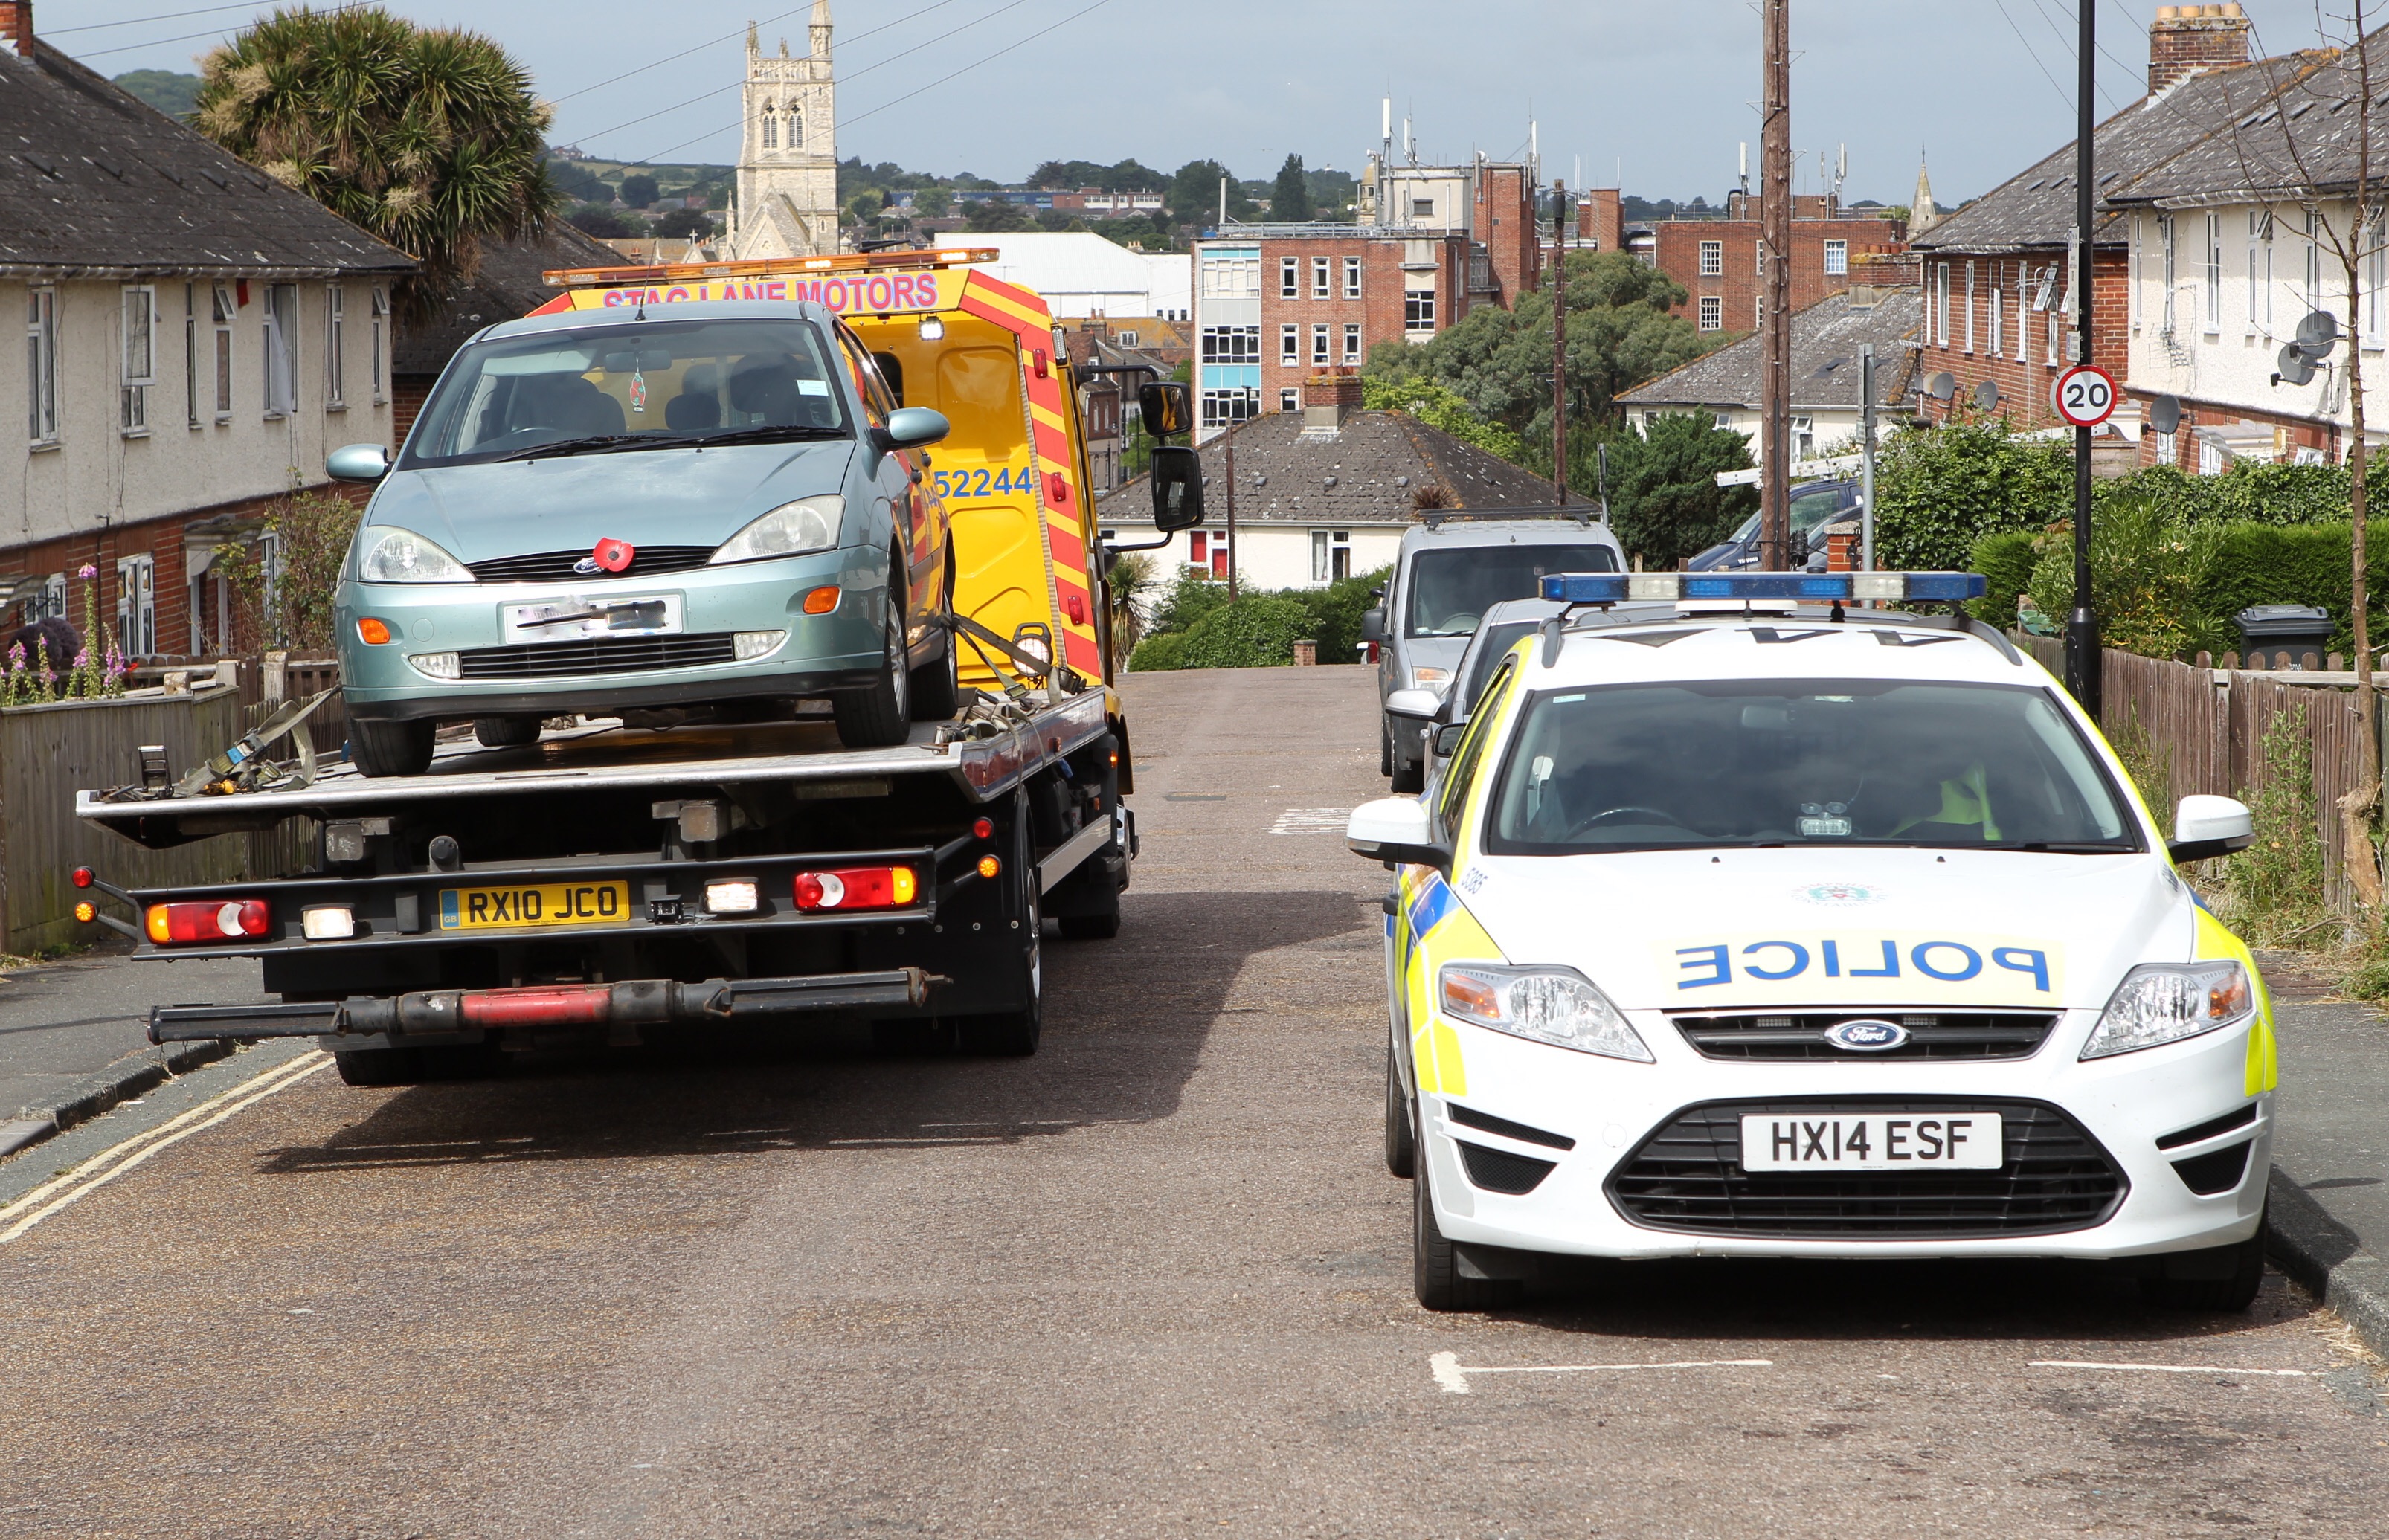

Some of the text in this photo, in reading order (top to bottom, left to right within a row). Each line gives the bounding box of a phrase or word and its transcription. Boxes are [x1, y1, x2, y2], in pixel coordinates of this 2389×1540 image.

[796, 272, 938, 313] MOTORS
[2067, 383, 2109, 408] 20
[934, 467, 1033, 499] 52244
[443, 915, 457, 924] GB
[469, 886, 617, 923] RX10 JCO
[1848, 1025, 1887, 1043] Ford
[1771, 1120, 1973, 1162] HX14 ESF
